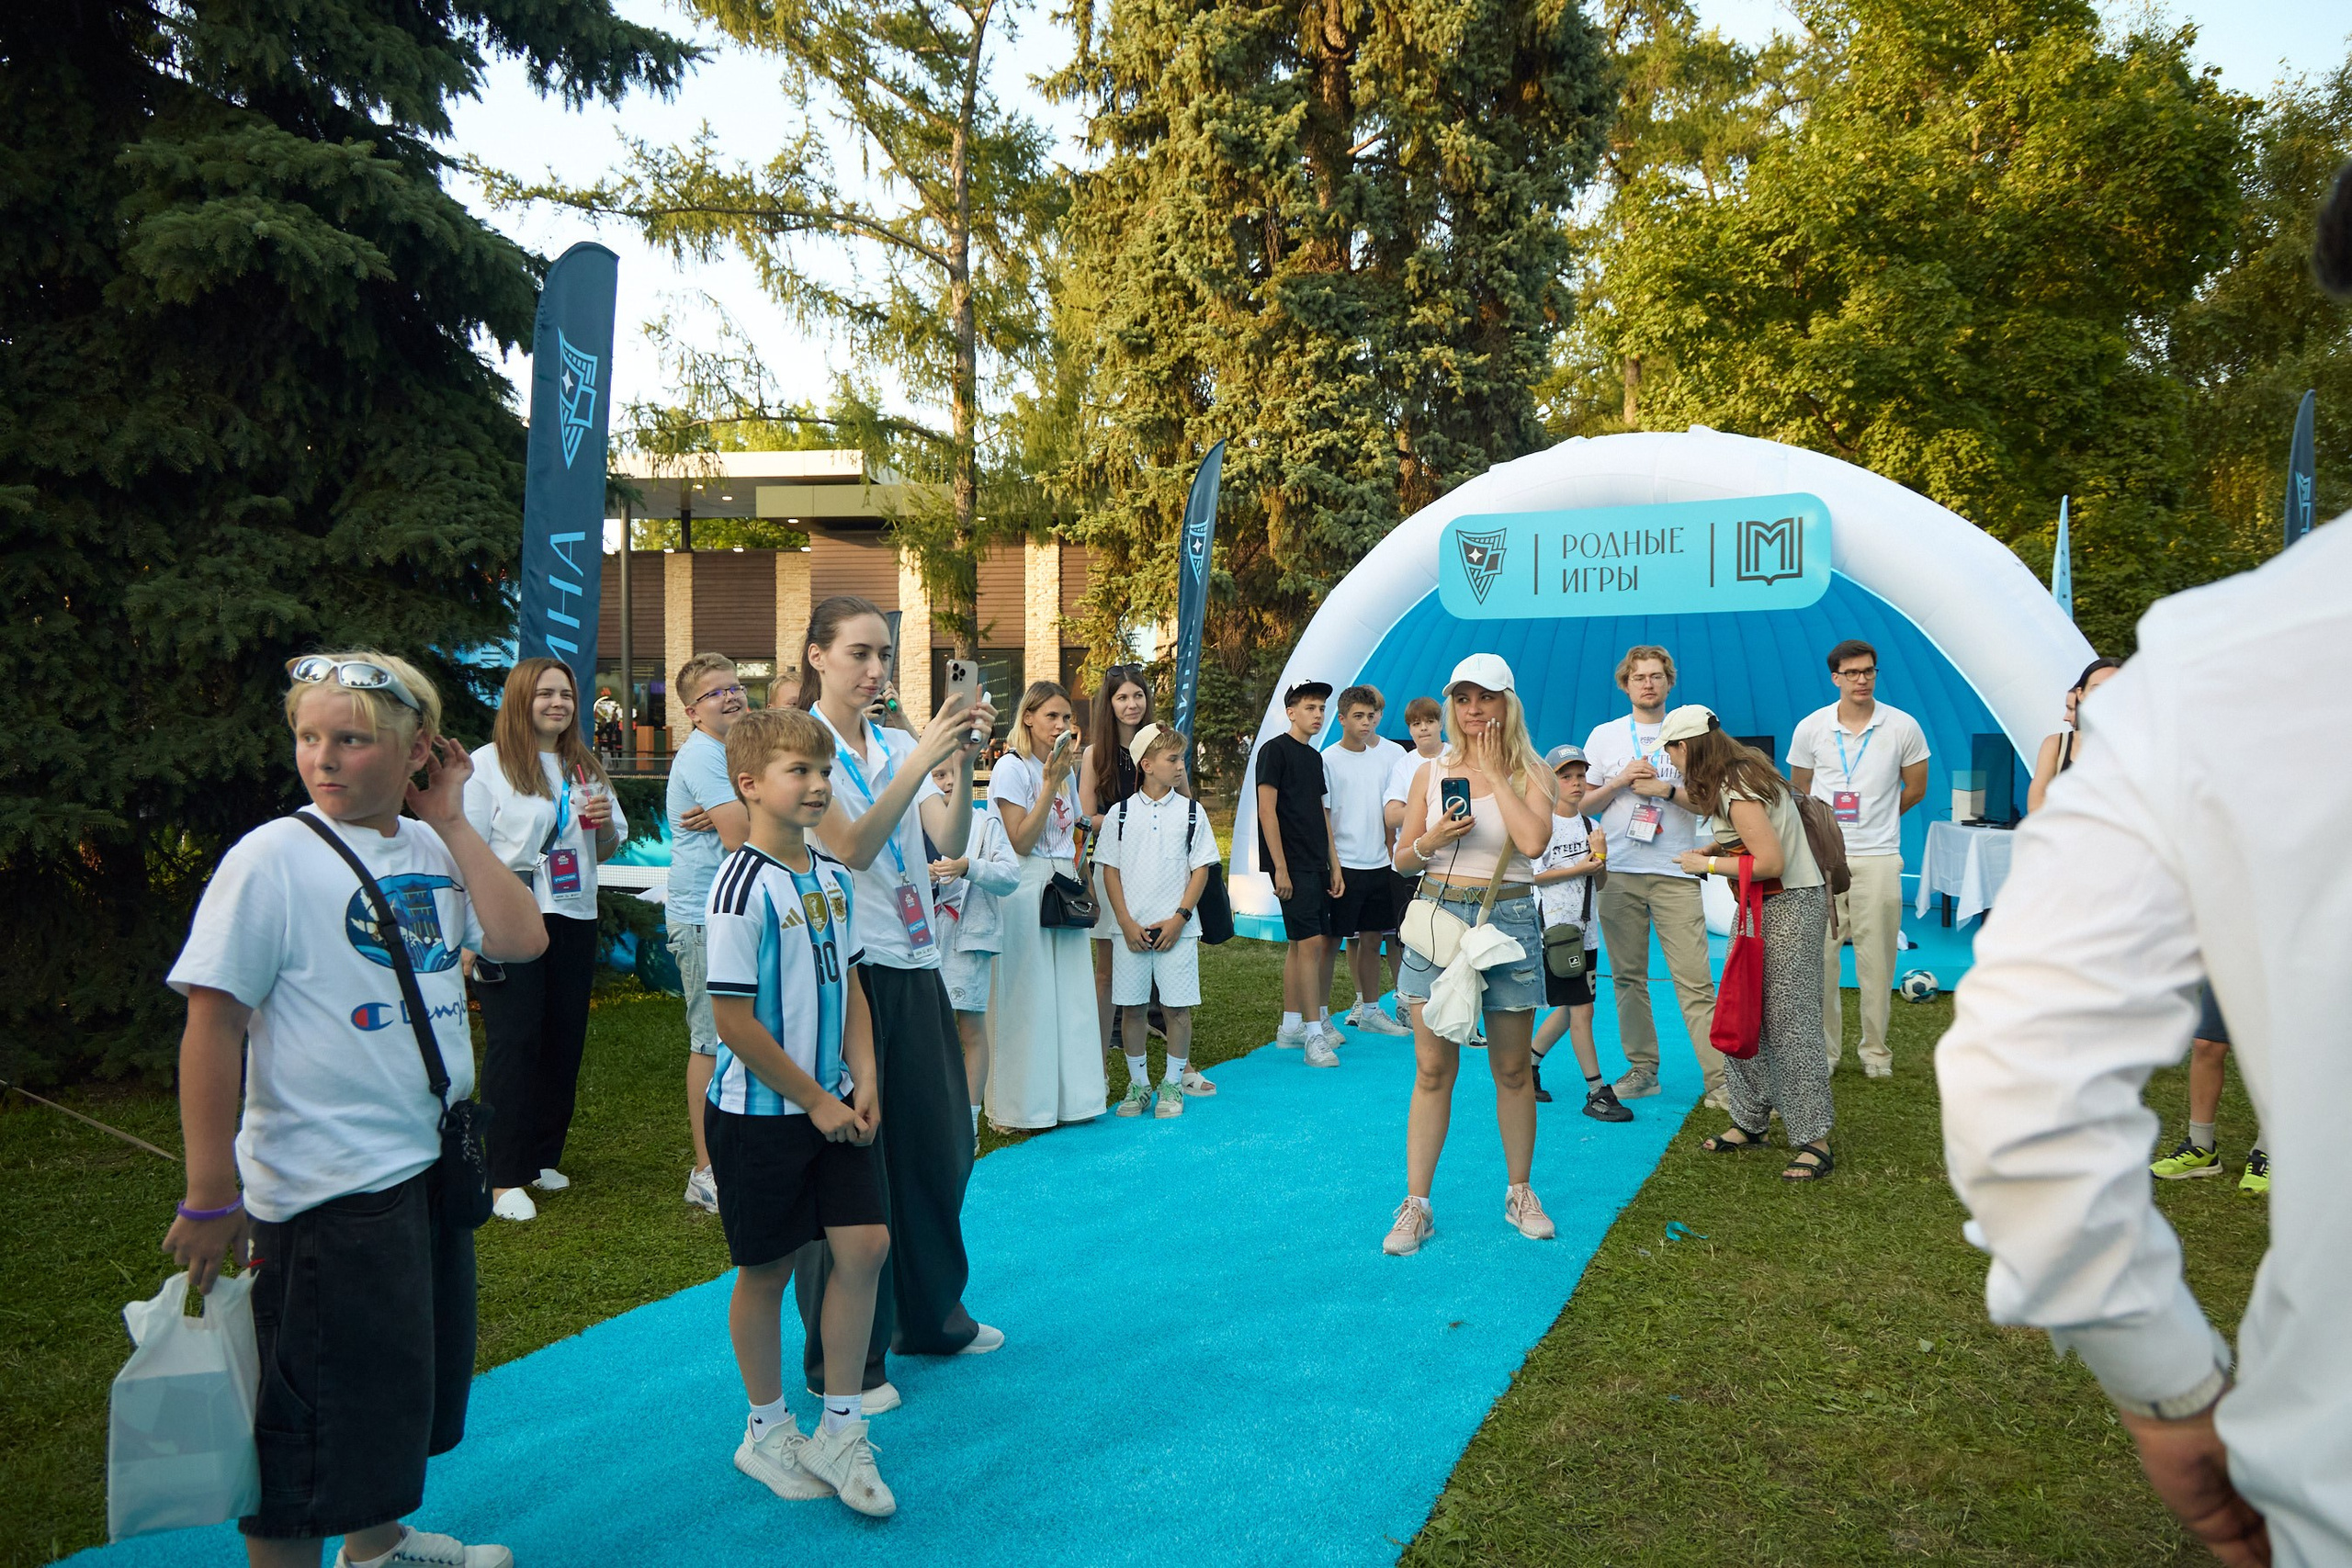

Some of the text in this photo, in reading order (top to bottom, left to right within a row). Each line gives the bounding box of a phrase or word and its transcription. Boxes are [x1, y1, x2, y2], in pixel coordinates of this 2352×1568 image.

[1562, 526, 1684, 559] РОДНЫЕ
[1562, 565, 1639, 594] ИГРЫ
[1553, 840, 1585, 855] STREET
[811, 941, 840, 986] 10
